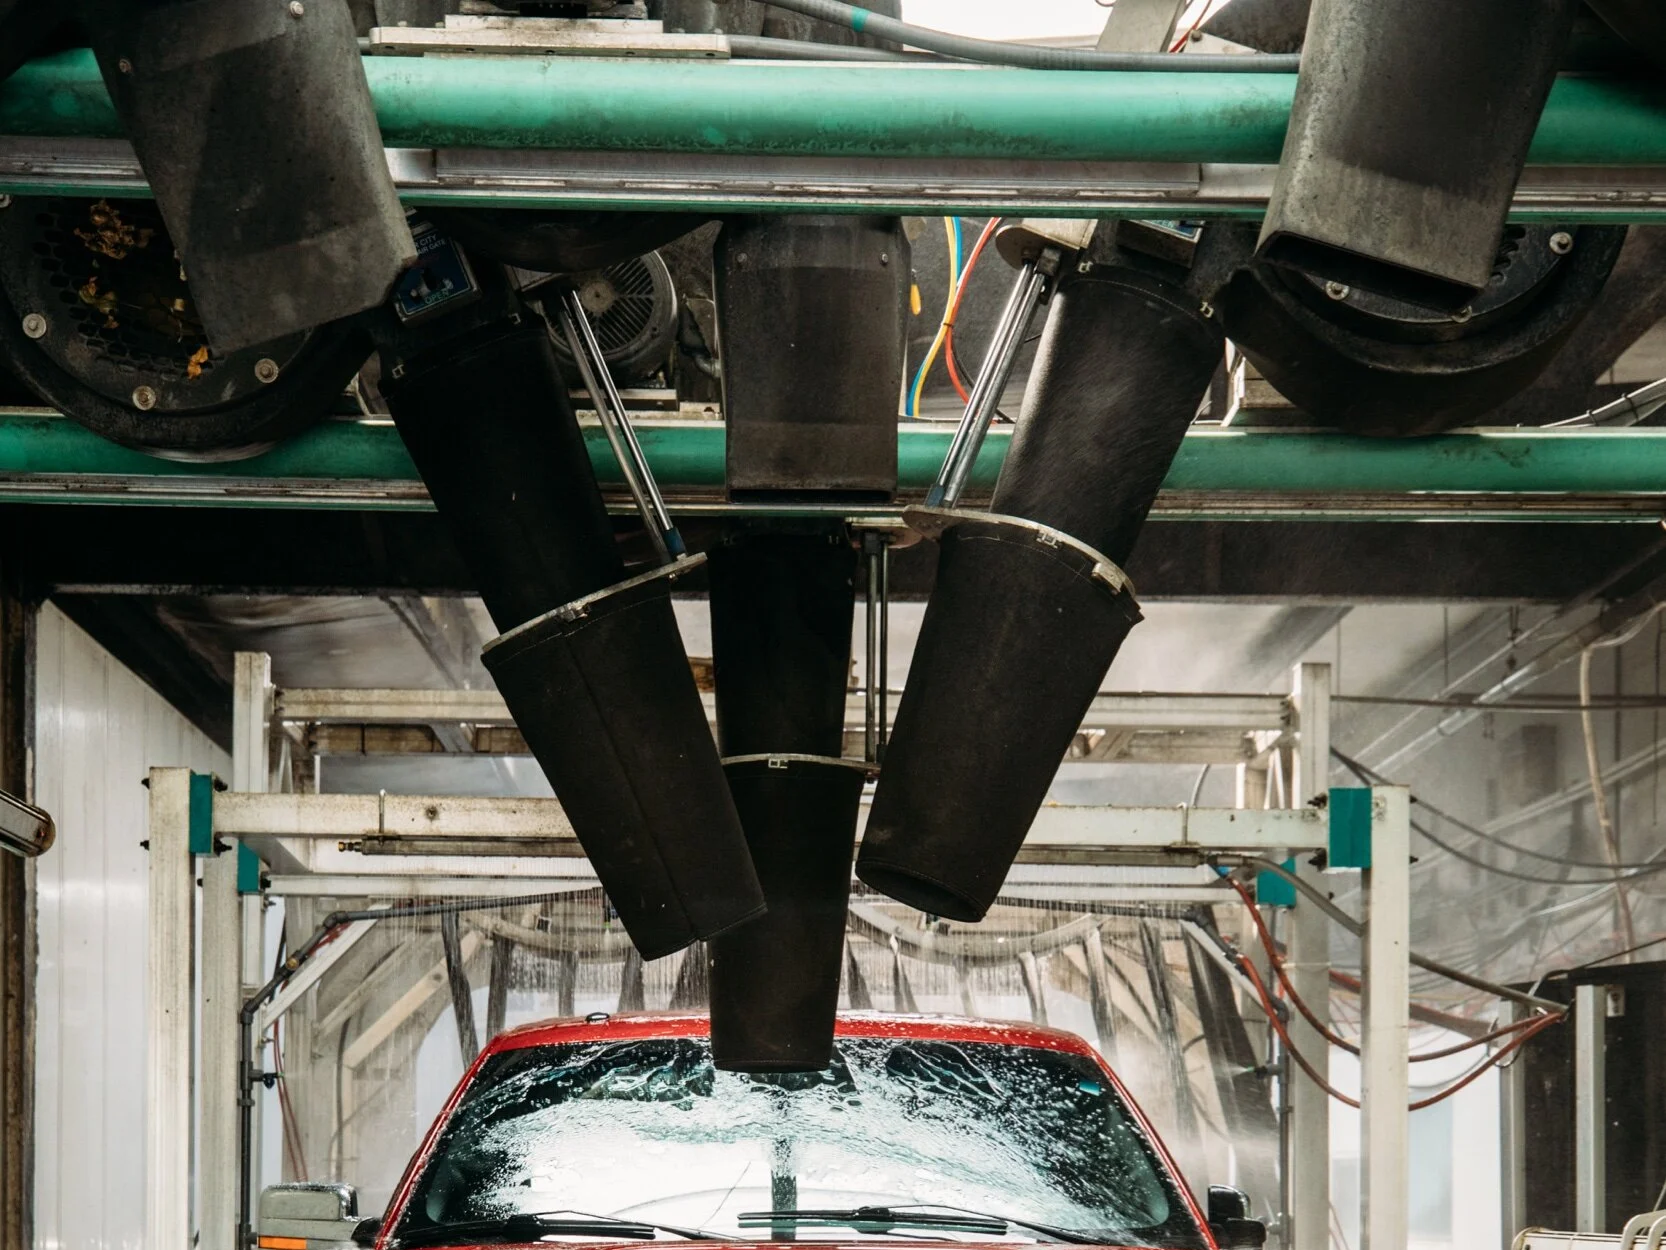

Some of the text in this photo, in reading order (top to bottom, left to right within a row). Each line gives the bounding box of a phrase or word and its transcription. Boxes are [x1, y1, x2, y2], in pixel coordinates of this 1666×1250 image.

[420, 234, 437, 246] CITY
[429, 239, 447, 250] GATE
[424, 290, 449, 304] OPEN
